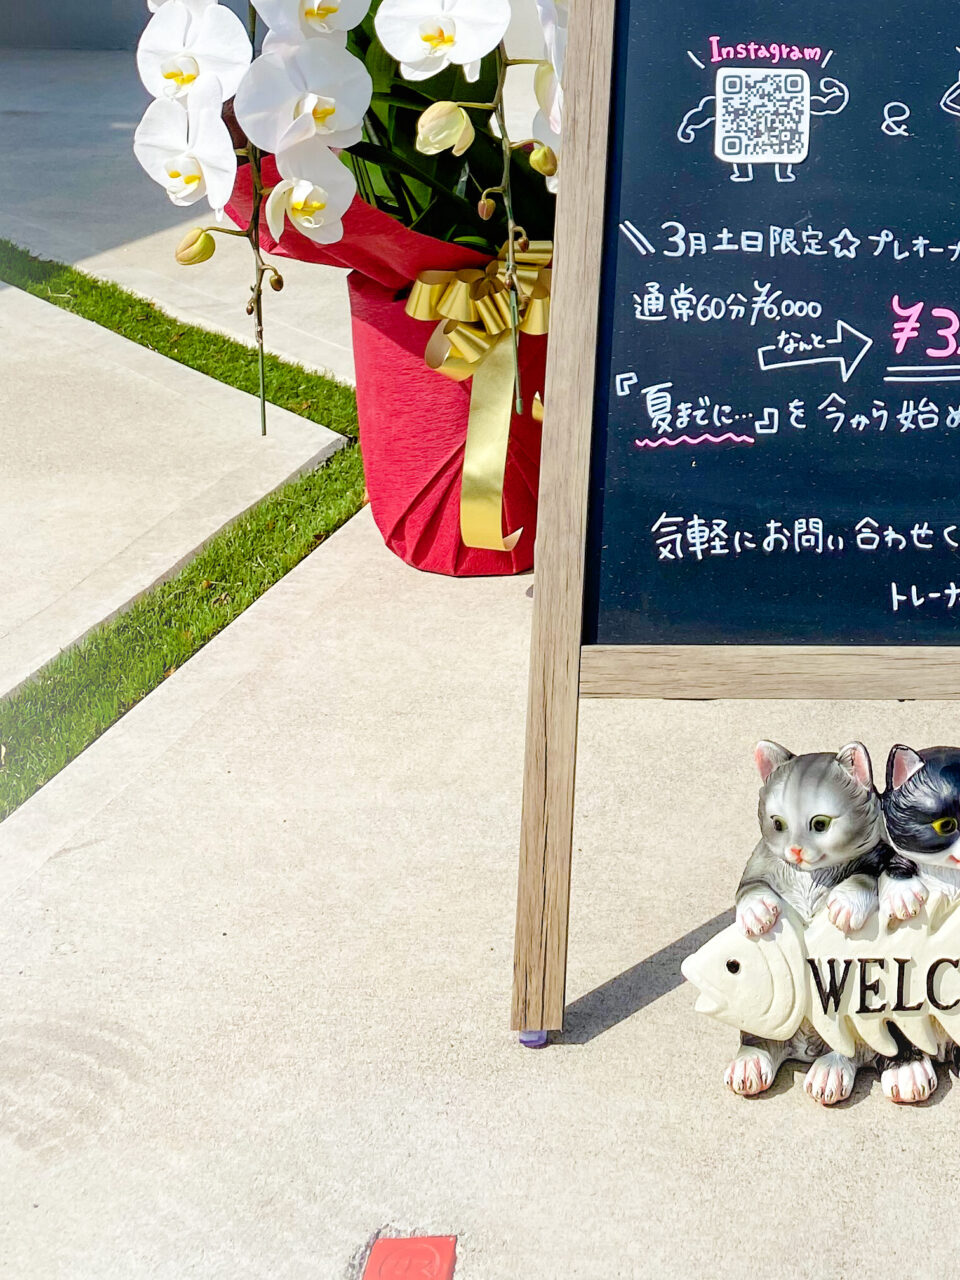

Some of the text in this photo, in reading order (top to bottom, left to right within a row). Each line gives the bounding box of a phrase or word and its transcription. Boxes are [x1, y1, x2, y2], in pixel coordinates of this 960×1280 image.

[710, 36, 822, 63] Instagram
[777, 330, 826, 354] なんと
